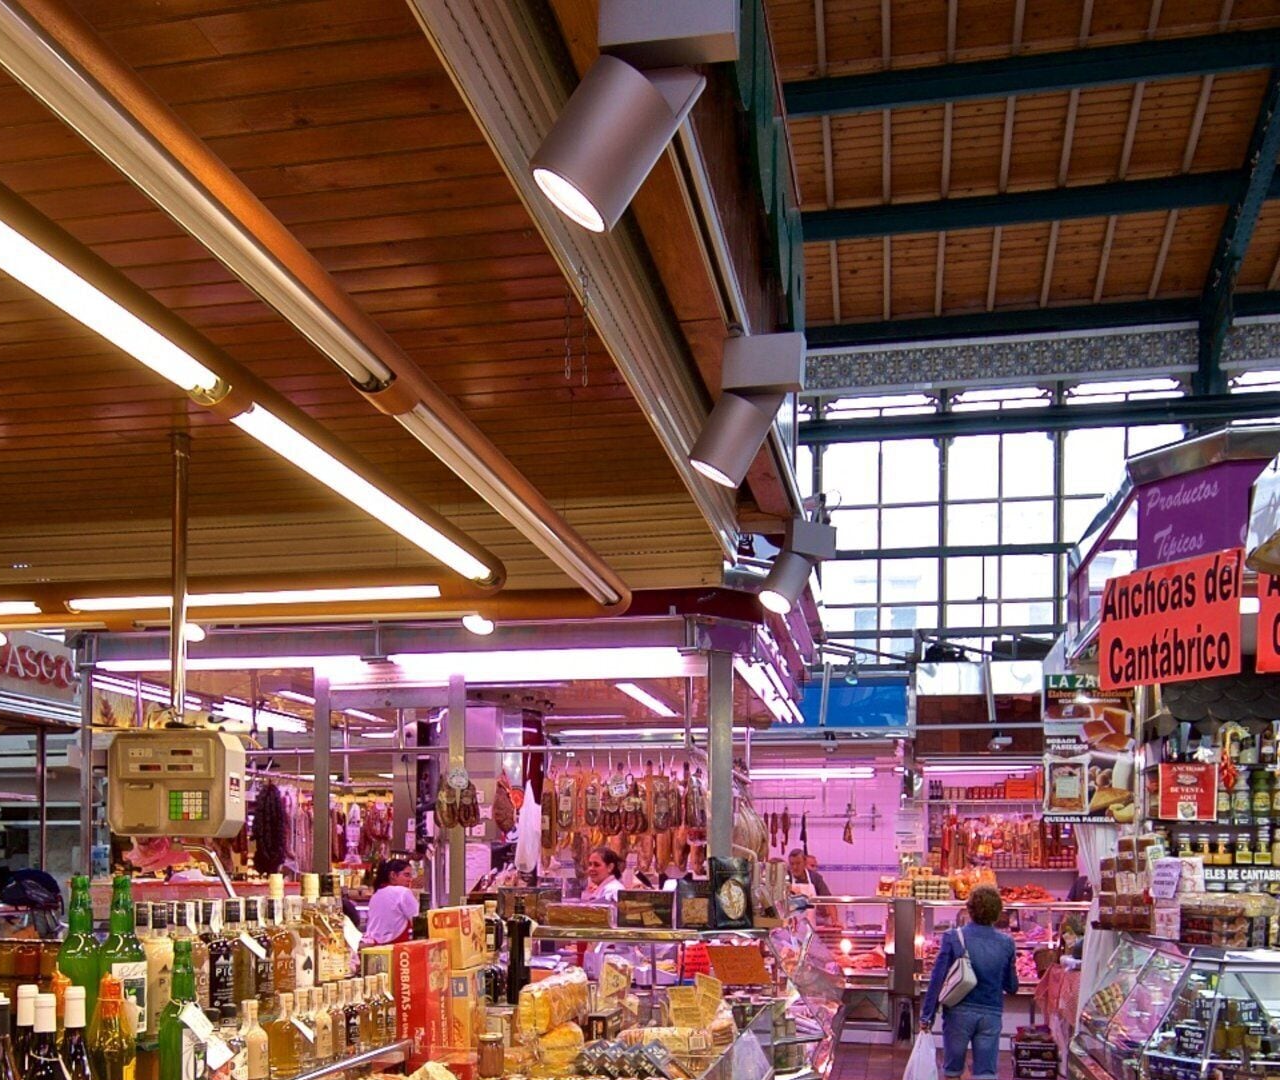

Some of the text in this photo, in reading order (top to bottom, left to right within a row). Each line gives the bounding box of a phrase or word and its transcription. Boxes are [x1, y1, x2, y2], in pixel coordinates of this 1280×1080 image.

[1146, 478, 1220, 518] Productos
[1154, 528, 1206, 560] Típicos
[1102, 557, 1240, 623] Anchoas del
[1108, 625, 1232, 685] Cantábrico
[1049, 675, 1098, 688] LA ZA
[1227, 870, 1238, 881] DE
[399, 951, 412, 1013] CORBATAS
